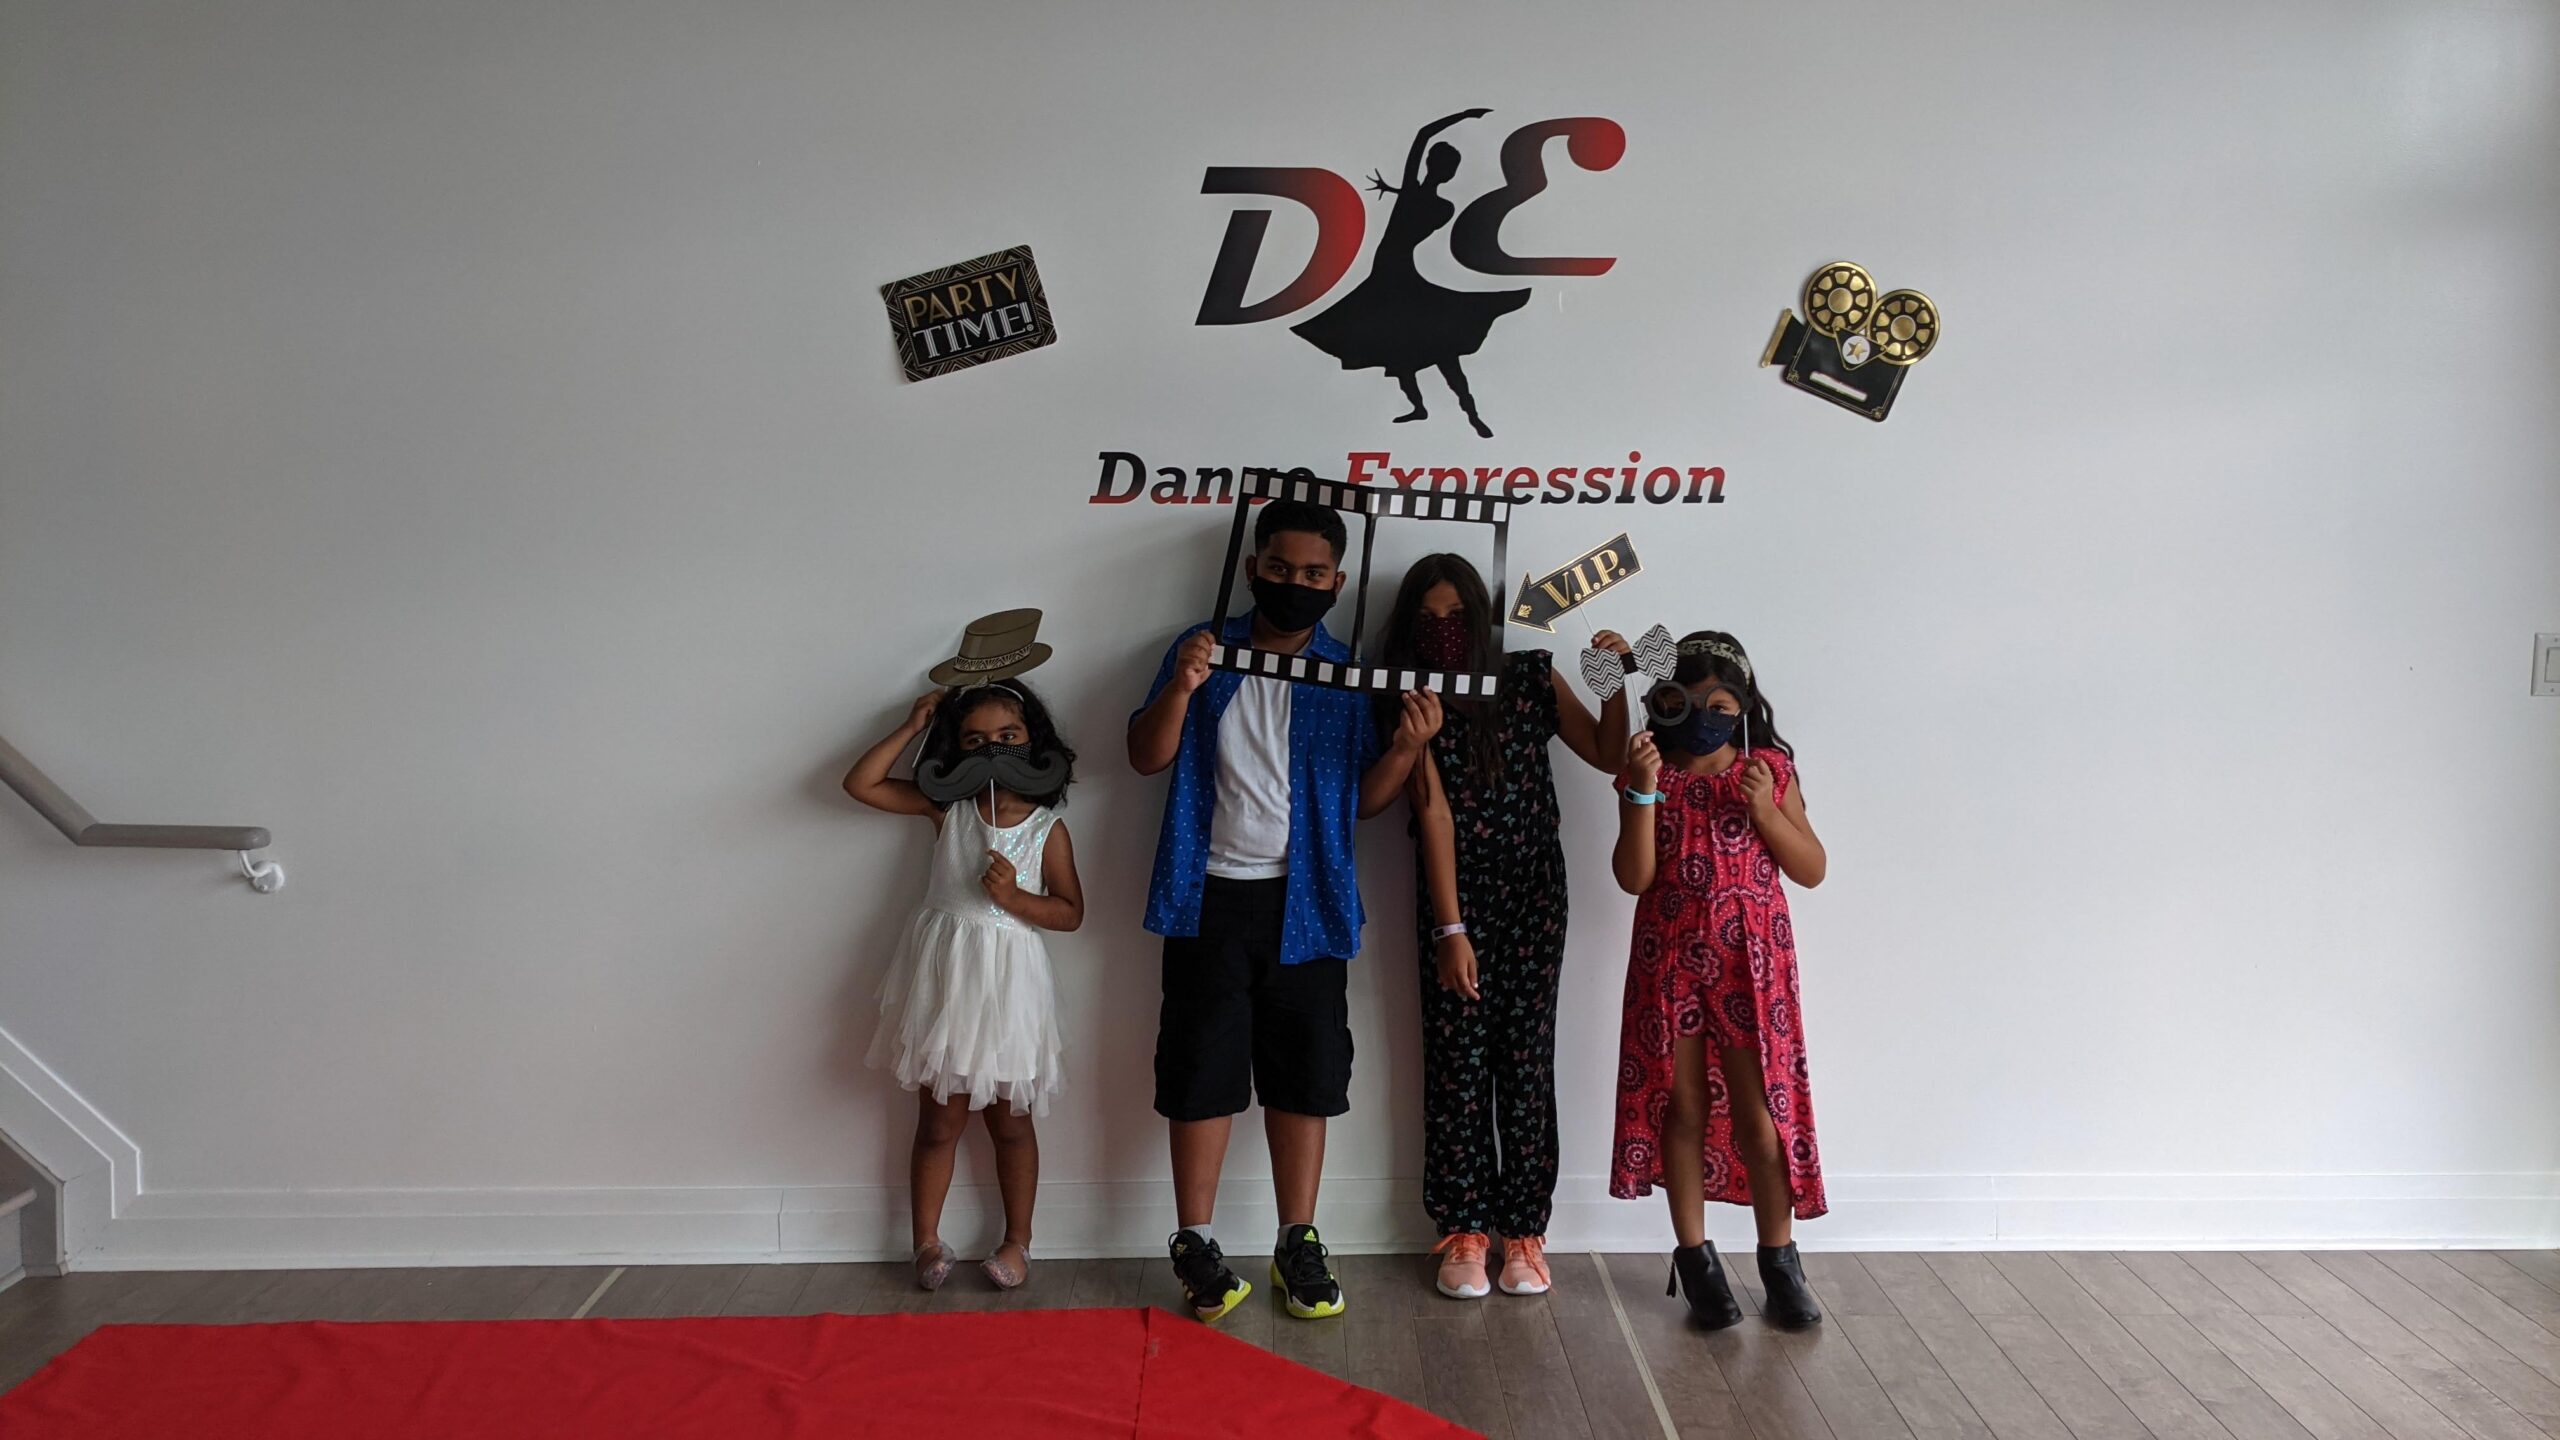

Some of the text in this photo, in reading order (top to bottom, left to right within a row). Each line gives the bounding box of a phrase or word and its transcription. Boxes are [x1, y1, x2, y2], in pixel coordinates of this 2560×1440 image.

[904, 269, 1018, 328] PARTY
[913, 302, 1034, 359] TIME!
[1088, 451, 1317, 505] Dan
[1541, 549, 1626, 609] V.I.P.
